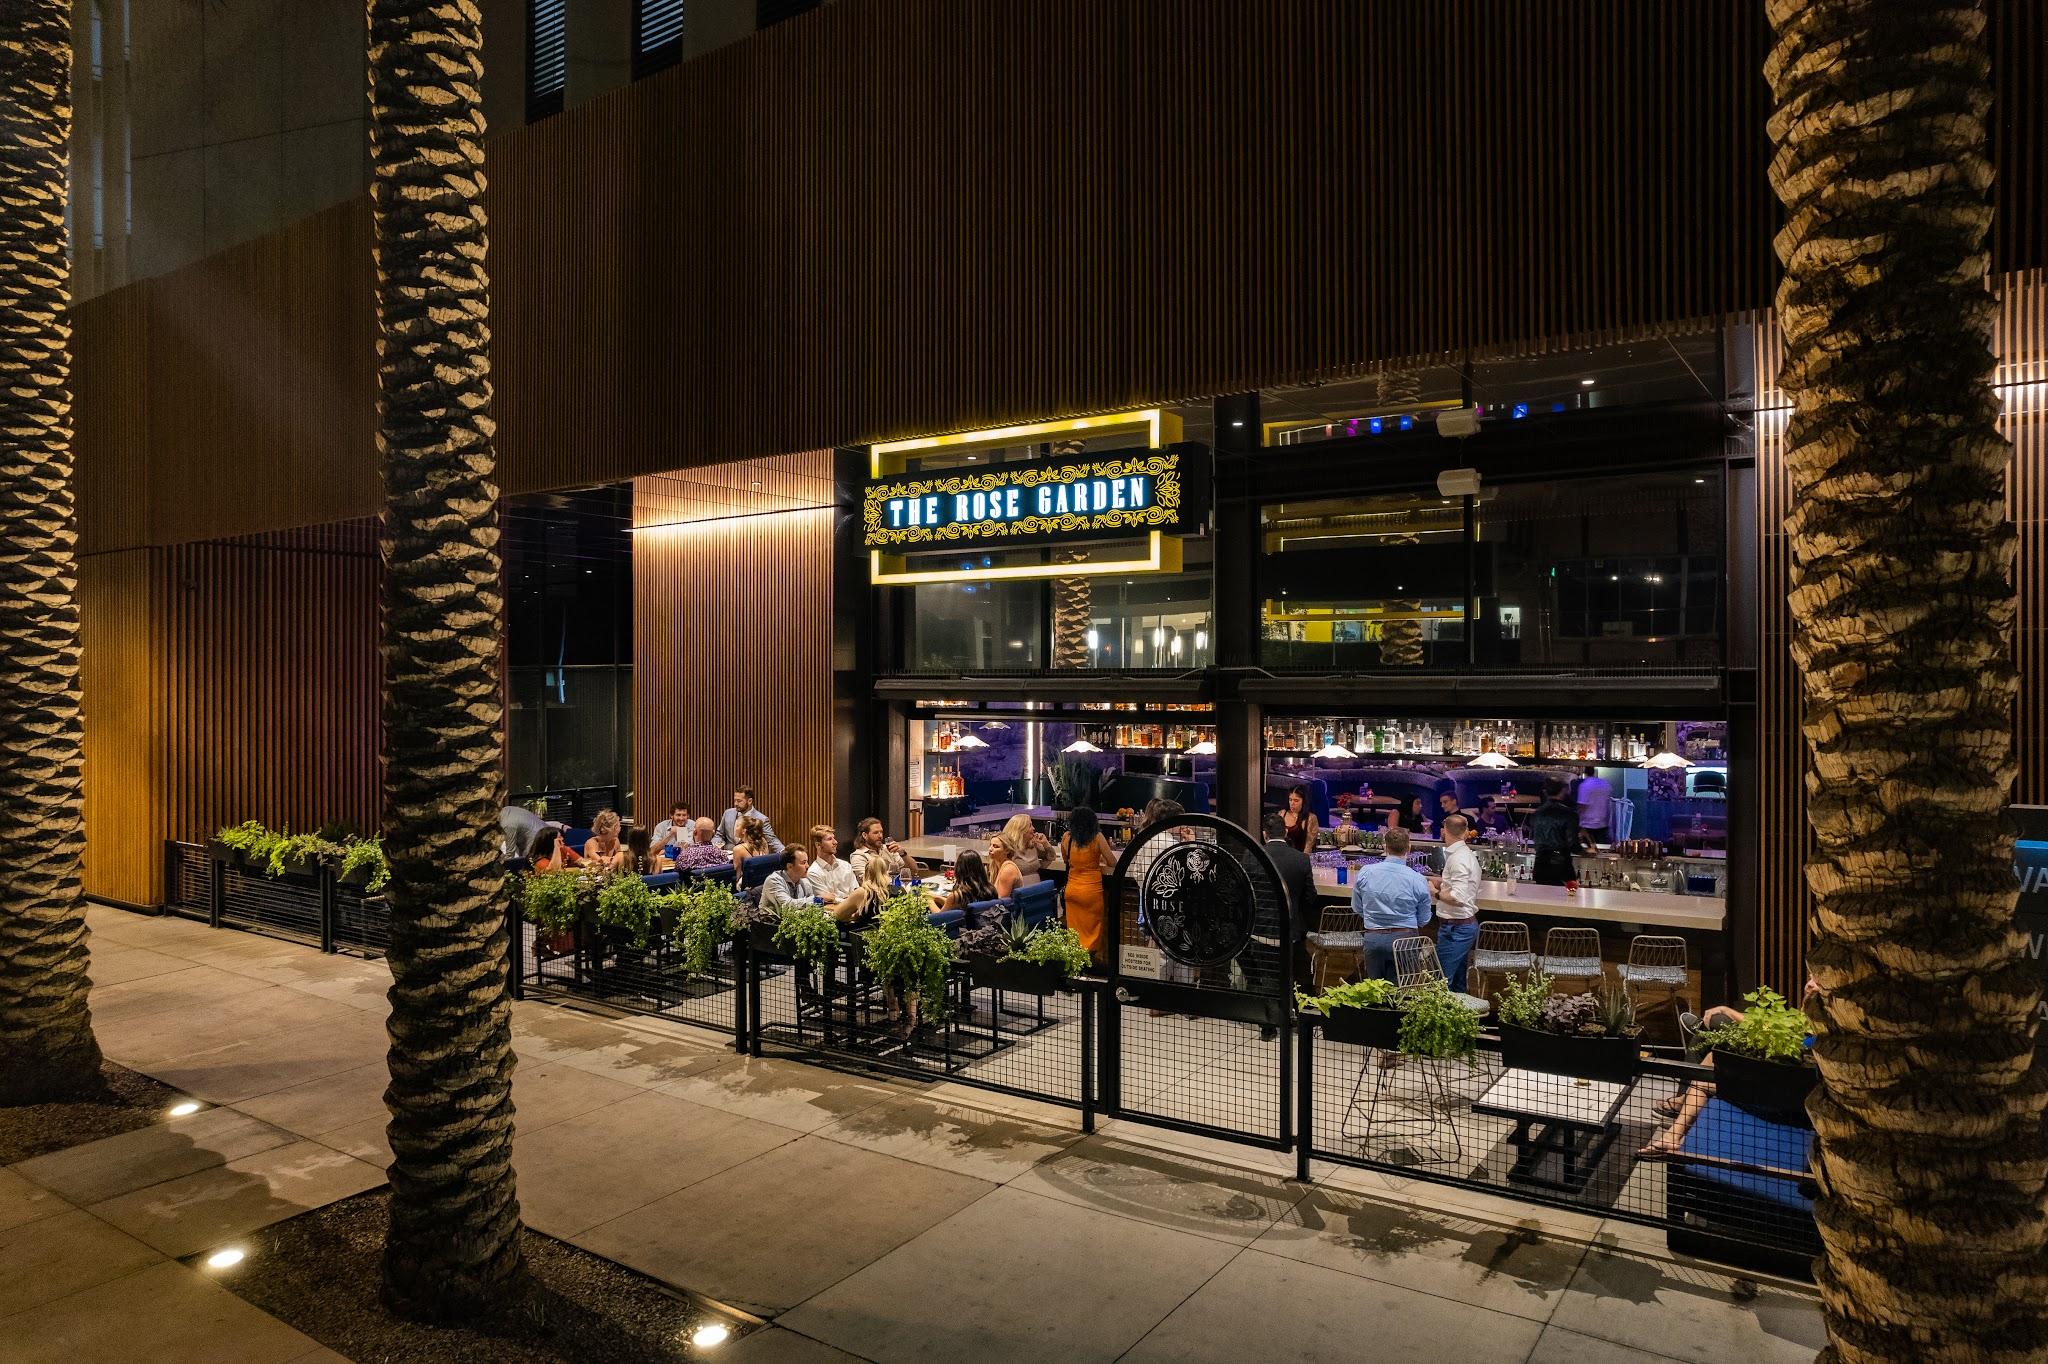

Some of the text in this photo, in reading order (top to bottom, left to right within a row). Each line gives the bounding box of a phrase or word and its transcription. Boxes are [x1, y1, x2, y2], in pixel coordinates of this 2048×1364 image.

[890, 477, 1145, 527] THE ROSE GARDEN
[1153, 898, 1184, 913] ROSE
